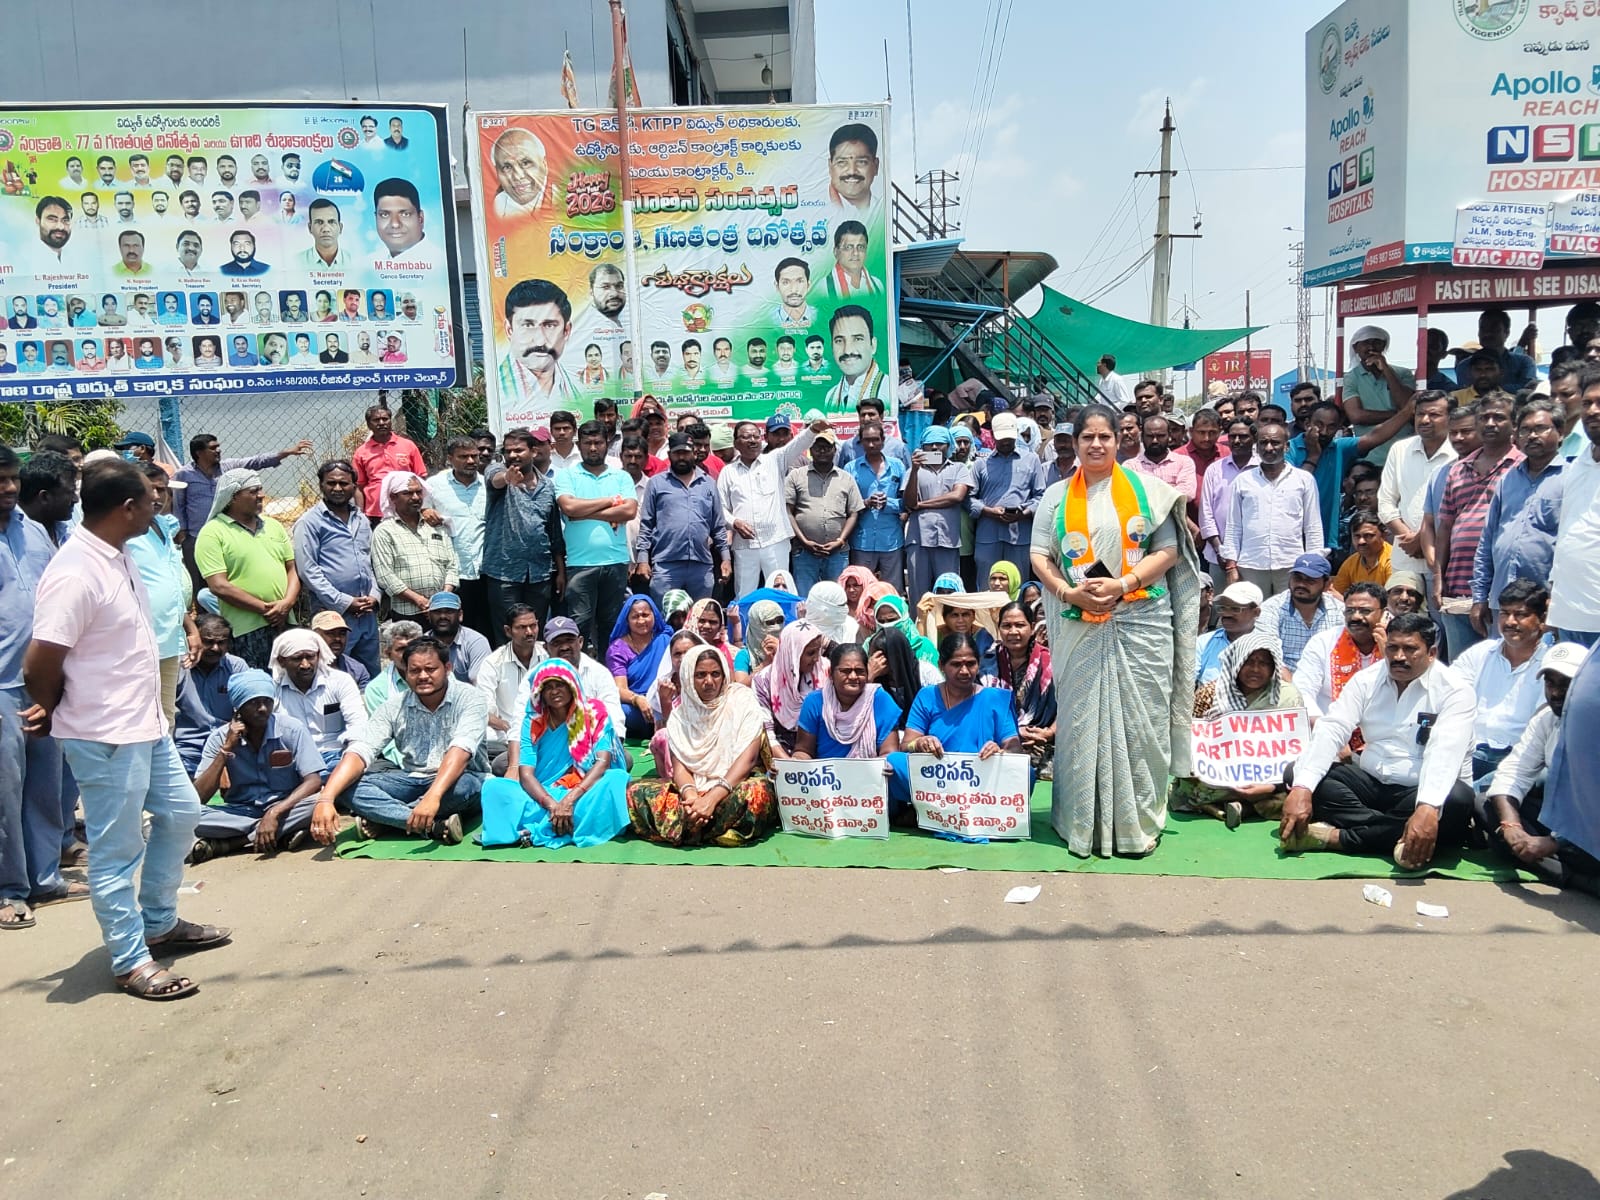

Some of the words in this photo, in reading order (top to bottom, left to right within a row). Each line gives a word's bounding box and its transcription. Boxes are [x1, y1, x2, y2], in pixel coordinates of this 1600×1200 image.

[1470, 25, 1512, 38] TGGENCO
[1565, 40, 1590, 51] మన
[1490, 71, 1581, 100] Apollo
[1523, 99, 1599, 117] REACH
[573, 118, 595, 132] TG
[642, 118, 682, 131] KTPP
[1329, 107, 1359, 141] Apollo
[76, 135, 89, 149] 77
[106, 136, 152, 151] గణతంత్ర
[157, 130, 199, 152] దినోత్సవ
[230, 133, 261, 148] ఉగాది
[265, 132, 333, 152] శుభాకాంక్షలు
[1340, 128, 1366, 153] REACH
[567, 171, 610, 192] Happy
[1329, 148, 1374, 196] NSR
[1490, 170, 1600, 190] HOSPITAL
[566, 190, 615, 217] 2026
[1329, 191, 1373, 222] HOSPITALS
[1493, 205, 1544, 215] ARTISENS
[655, 223, 738, 252] గణతంత్ర
[747, 219, 827, 252] దినోత్సవ
[1468, 227, 1491, 237] JLM,
[1495, 229, 1536, 239] Sub-Eng.
[1555, 236, 1599, 252] TVAC
[374, 261, 432, 270] M.Rambabu
[1458, 250, 1501, 264] TVAC
[1506, 251, 1540, 267] JAC
[42, 274, 75, 282] Rajeshwar
[313, 279, 343, 287] Secretary
[398, 272, 424, 281] Secretary
[1435, 278, 1491, 300] FASTER
[1494, 276, 1529, 298] WILL
[1533, 276, 1561, 296] SEE
[1564, 274, 1600, 295] DISA
[1380, 291, 1391, 308] LIVE
[1391, 286, 1416, 306] JOYFULLY
[189, 376, 244, 391] సంఘం
[759, 391, 775, 399] 327
[1191, 721, 1223, 738] WE
[1228, 713, 1298, 733] WANT
[1197, 738, 1302, 760] ARTISANS
